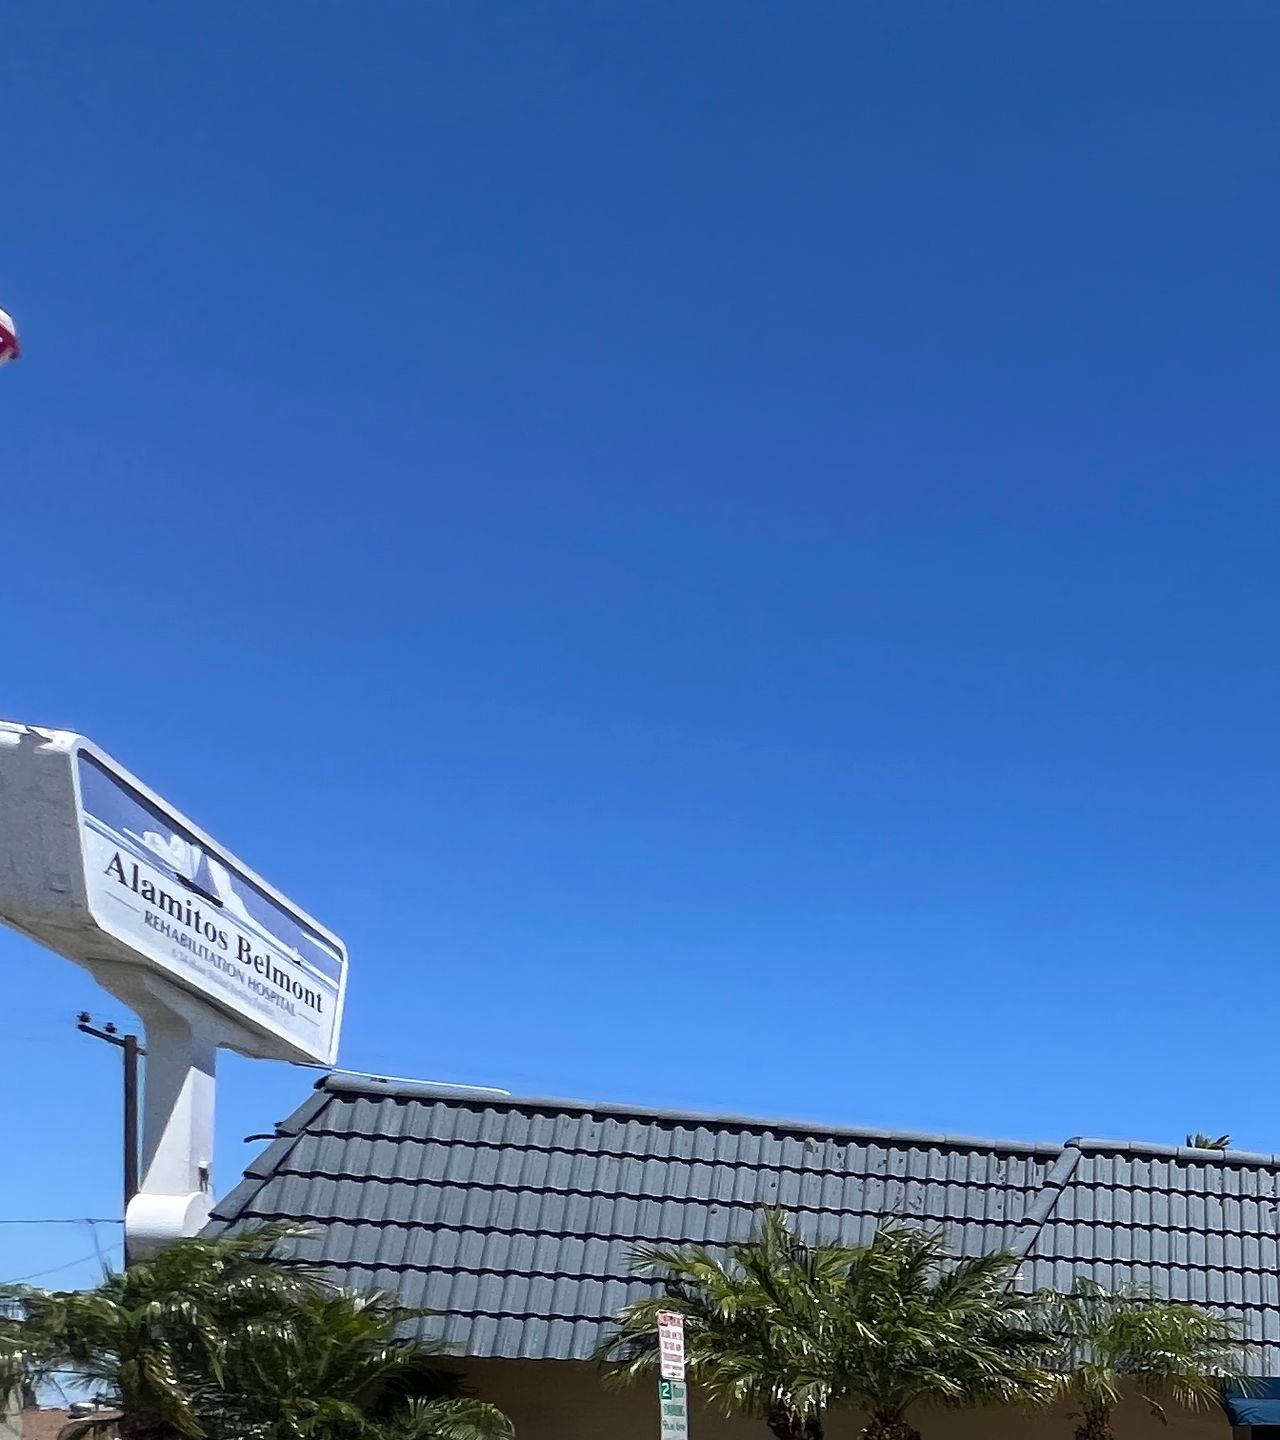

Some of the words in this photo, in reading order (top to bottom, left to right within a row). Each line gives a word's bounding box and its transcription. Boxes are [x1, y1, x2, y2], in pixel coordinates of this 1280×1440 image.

[103, 851, 229, 951] Alamitos
[236, 934, 324, 1014] Belmont
[144, 910, 245, 985] REHABILITATION
[247, 975, 296, 1017] HOSPITAL
[661, 1382, 670, 1397] 2
